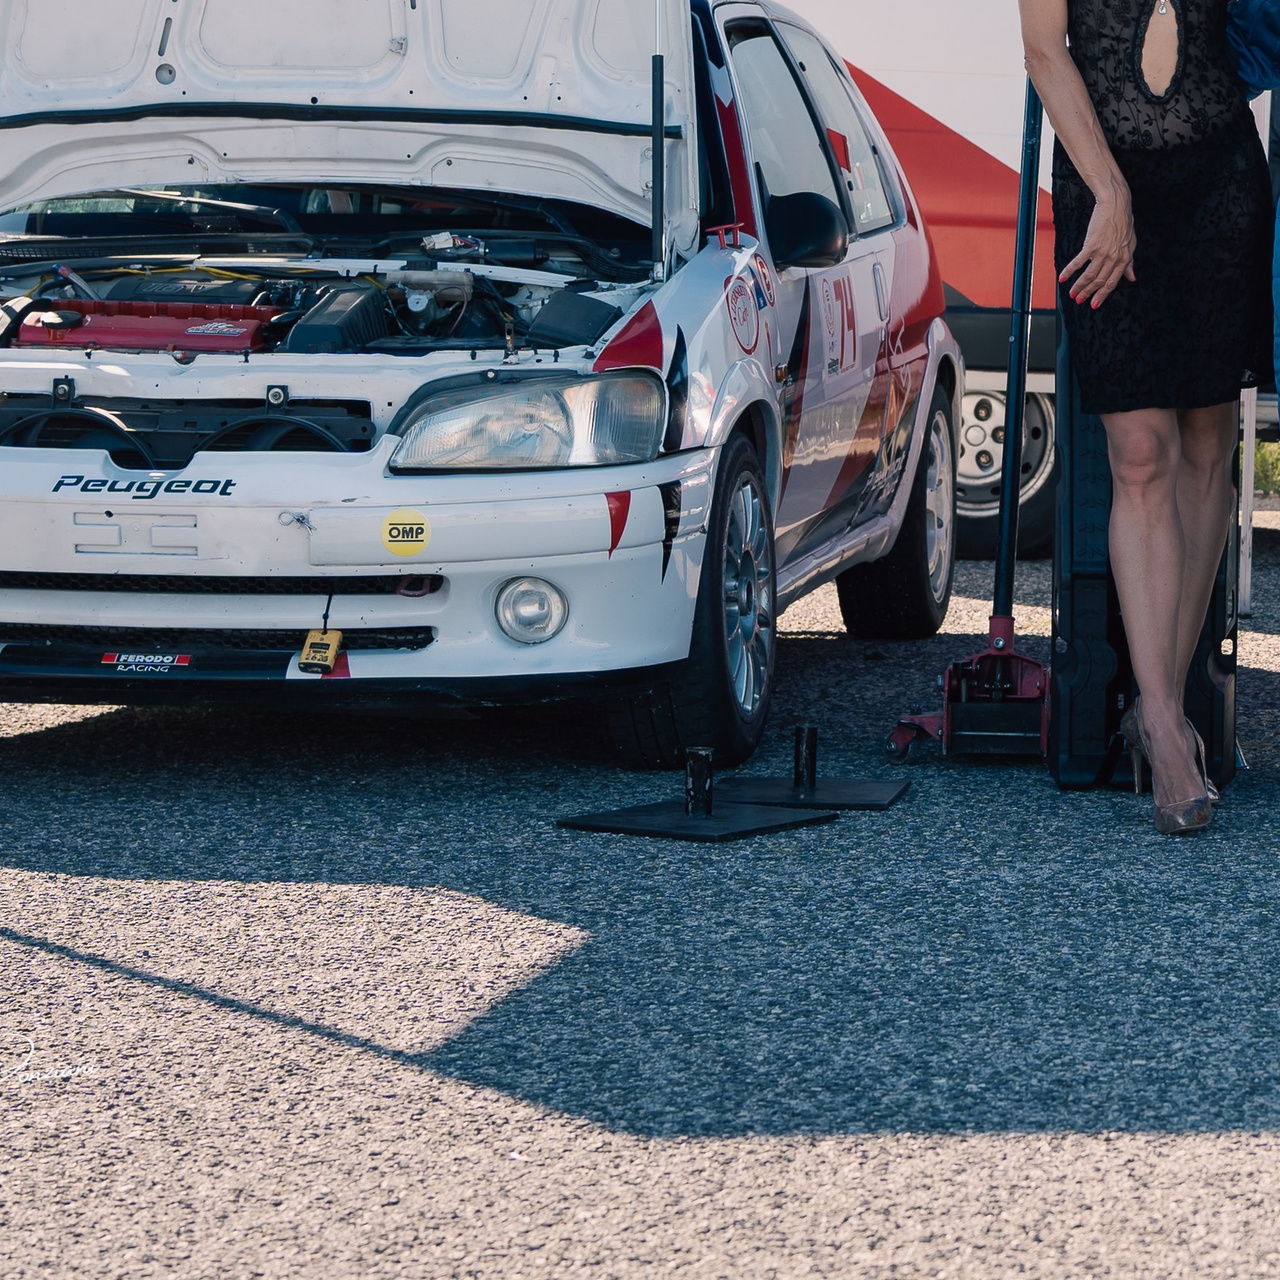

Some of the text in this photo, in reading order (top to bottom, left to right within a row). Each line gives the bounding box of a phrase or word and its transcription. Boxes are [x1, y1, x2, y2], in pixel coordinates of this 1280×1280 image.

[832, 275, 858, 370] 74
[51, 475, 237, 499] Peugeot
[387, 525, 425, 541] OMP
[119, 654, 174, 663] FERODO
[116, 664, 171, 673] RACING
